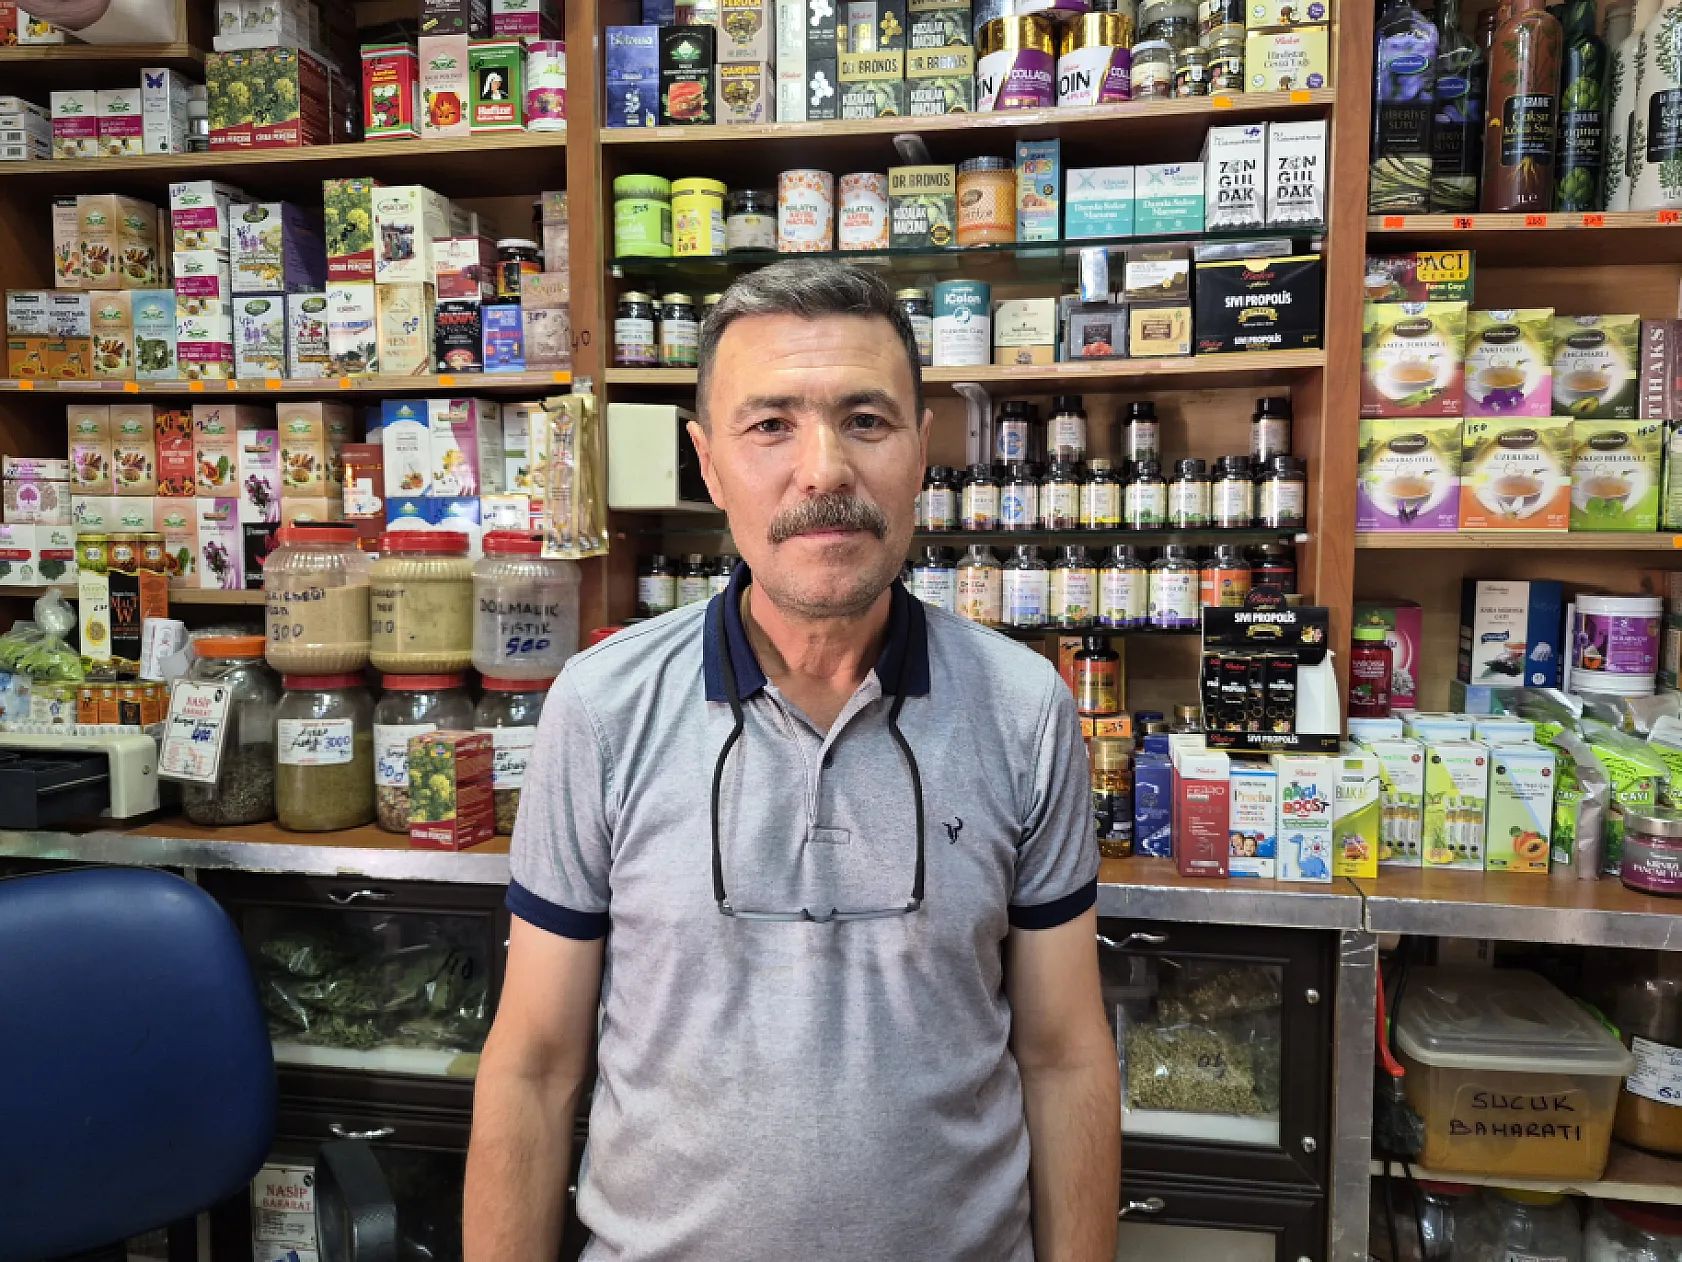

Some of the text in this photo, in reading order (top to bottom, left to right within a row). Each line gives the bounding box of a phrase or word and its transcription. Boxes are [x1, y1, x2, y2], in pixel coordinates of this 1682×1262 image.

[909, 173, 951, 187] BRONOS
[1246, 290, 1293, 306] PROPOLİS
[1253, 610, 1297, 623] PROPOLİS
[1471, 1092, 1576, 1112] SUCUK
[1449, 1119, 1582, 1142] BAHARATI
